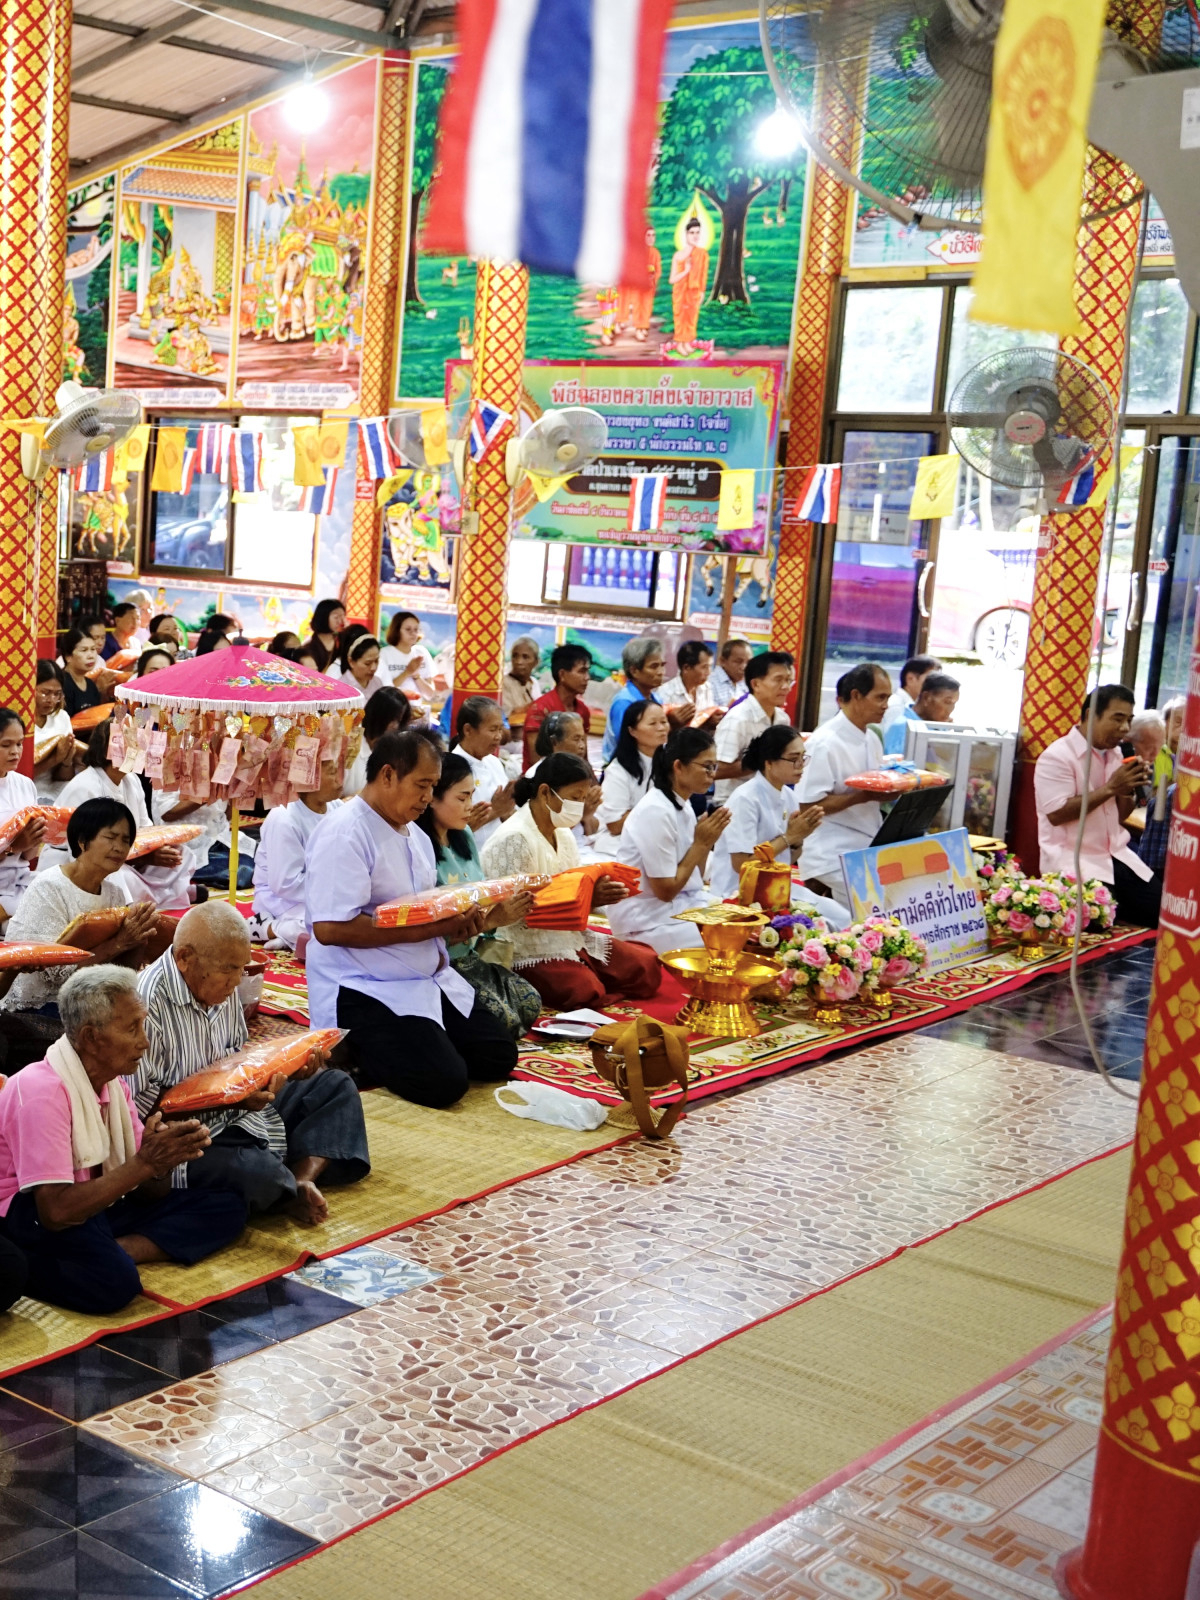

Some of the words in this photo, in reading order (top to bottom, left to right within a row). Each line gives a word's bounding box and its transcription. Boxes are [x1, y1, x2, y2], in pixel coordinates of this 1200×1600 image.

[552, 377, 753, 406] พิธีฉลองตราตั้งเจ้าอาวาส
